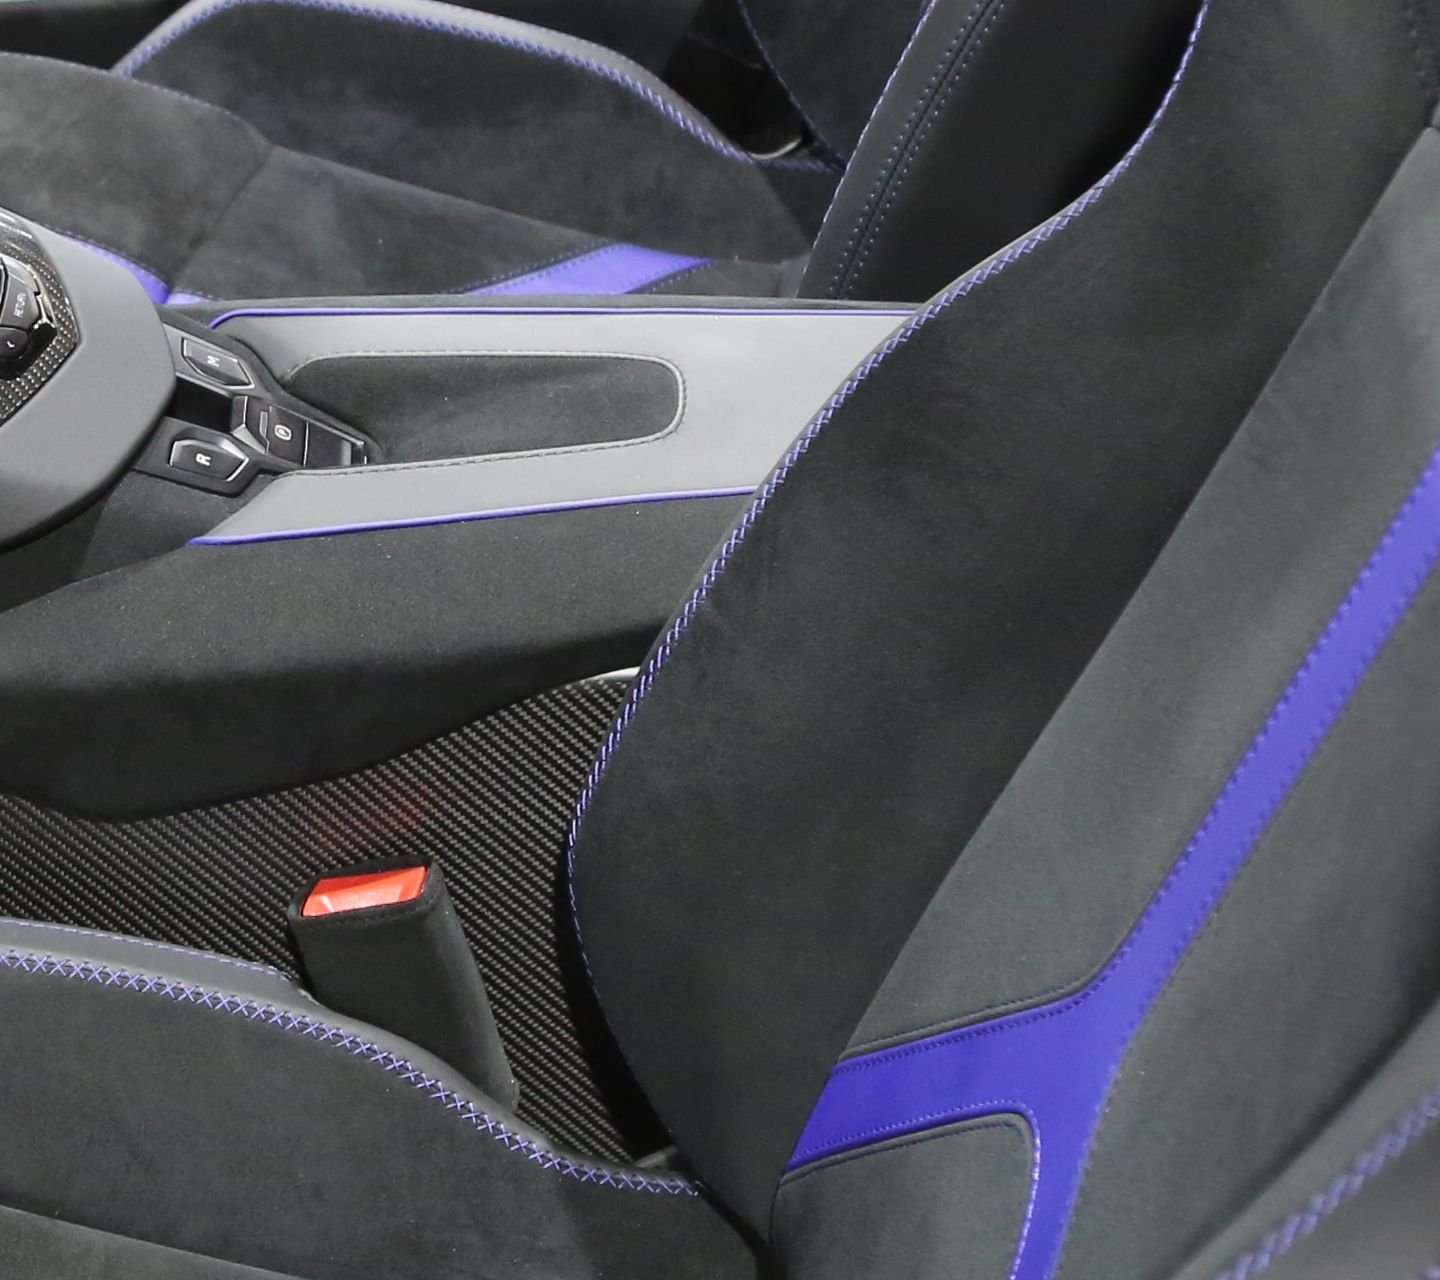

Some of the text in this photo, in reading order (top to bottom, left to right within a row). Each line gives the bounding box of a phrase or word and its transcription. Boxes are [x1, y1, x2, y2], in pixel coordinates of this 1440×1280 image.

[13, 292, 27, 319] RETURN
[207, 355, 219, 367] M
[196, 453, 211, 466] R
